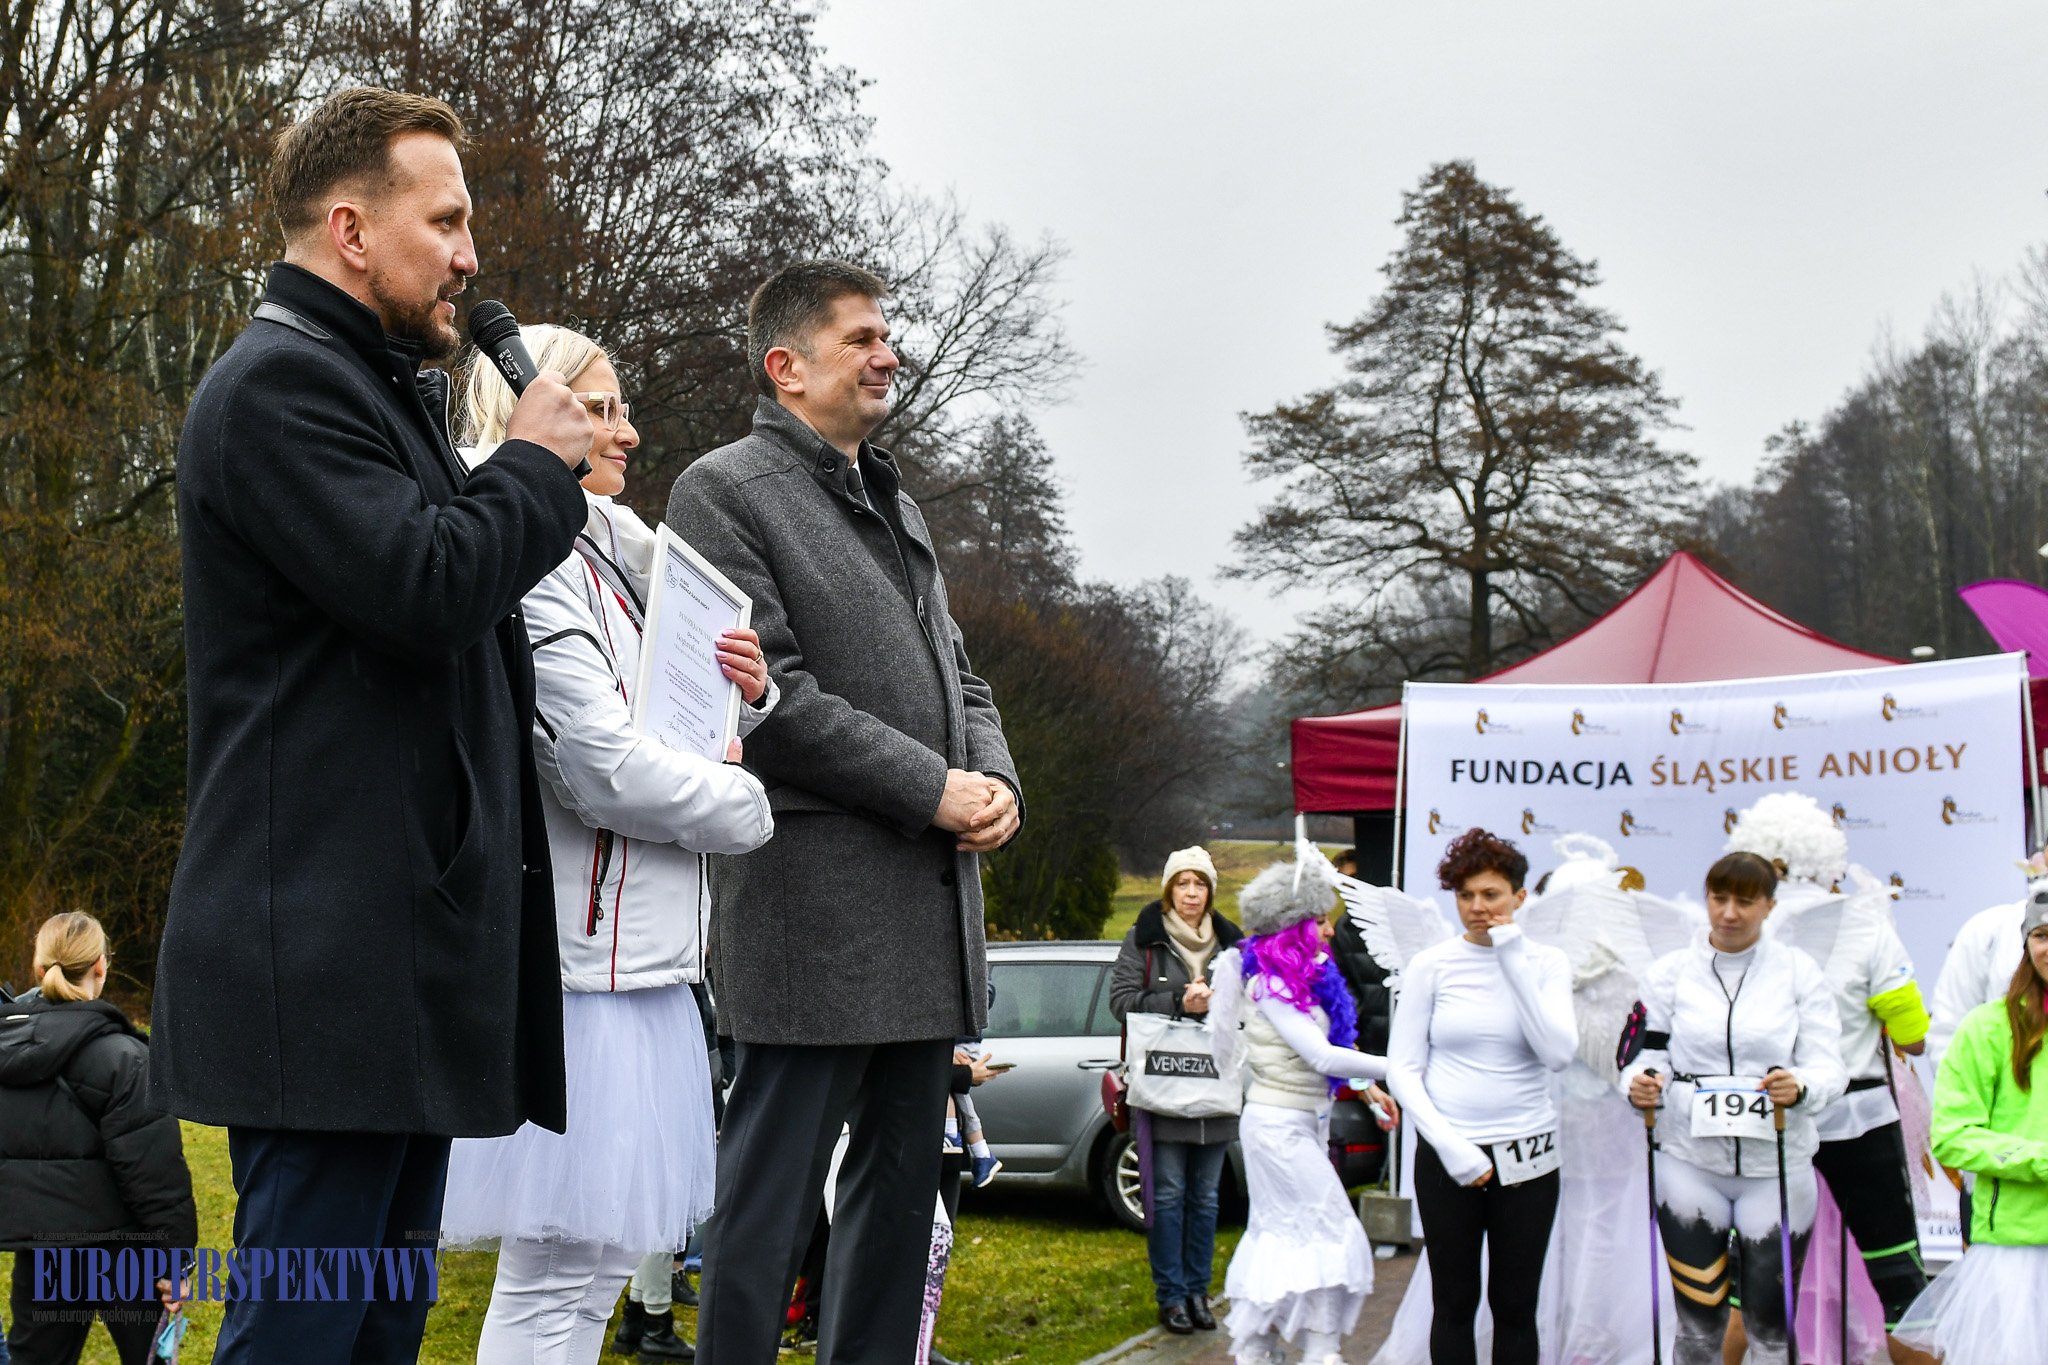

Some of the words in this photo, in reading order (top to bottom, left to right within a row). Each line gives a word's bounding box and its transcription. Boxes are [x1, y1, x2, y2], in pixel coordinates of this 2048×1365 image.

[1451, 759, 1633, 789] FUNDACJA
[1651, 755, 1799, 793] ŚLĄSKIE
[1819, 743, 1967, 778] ANIOŁY
[1704, 1094, 1772, 1119] 194
[1506, 1132, 1555, 1163] 122
